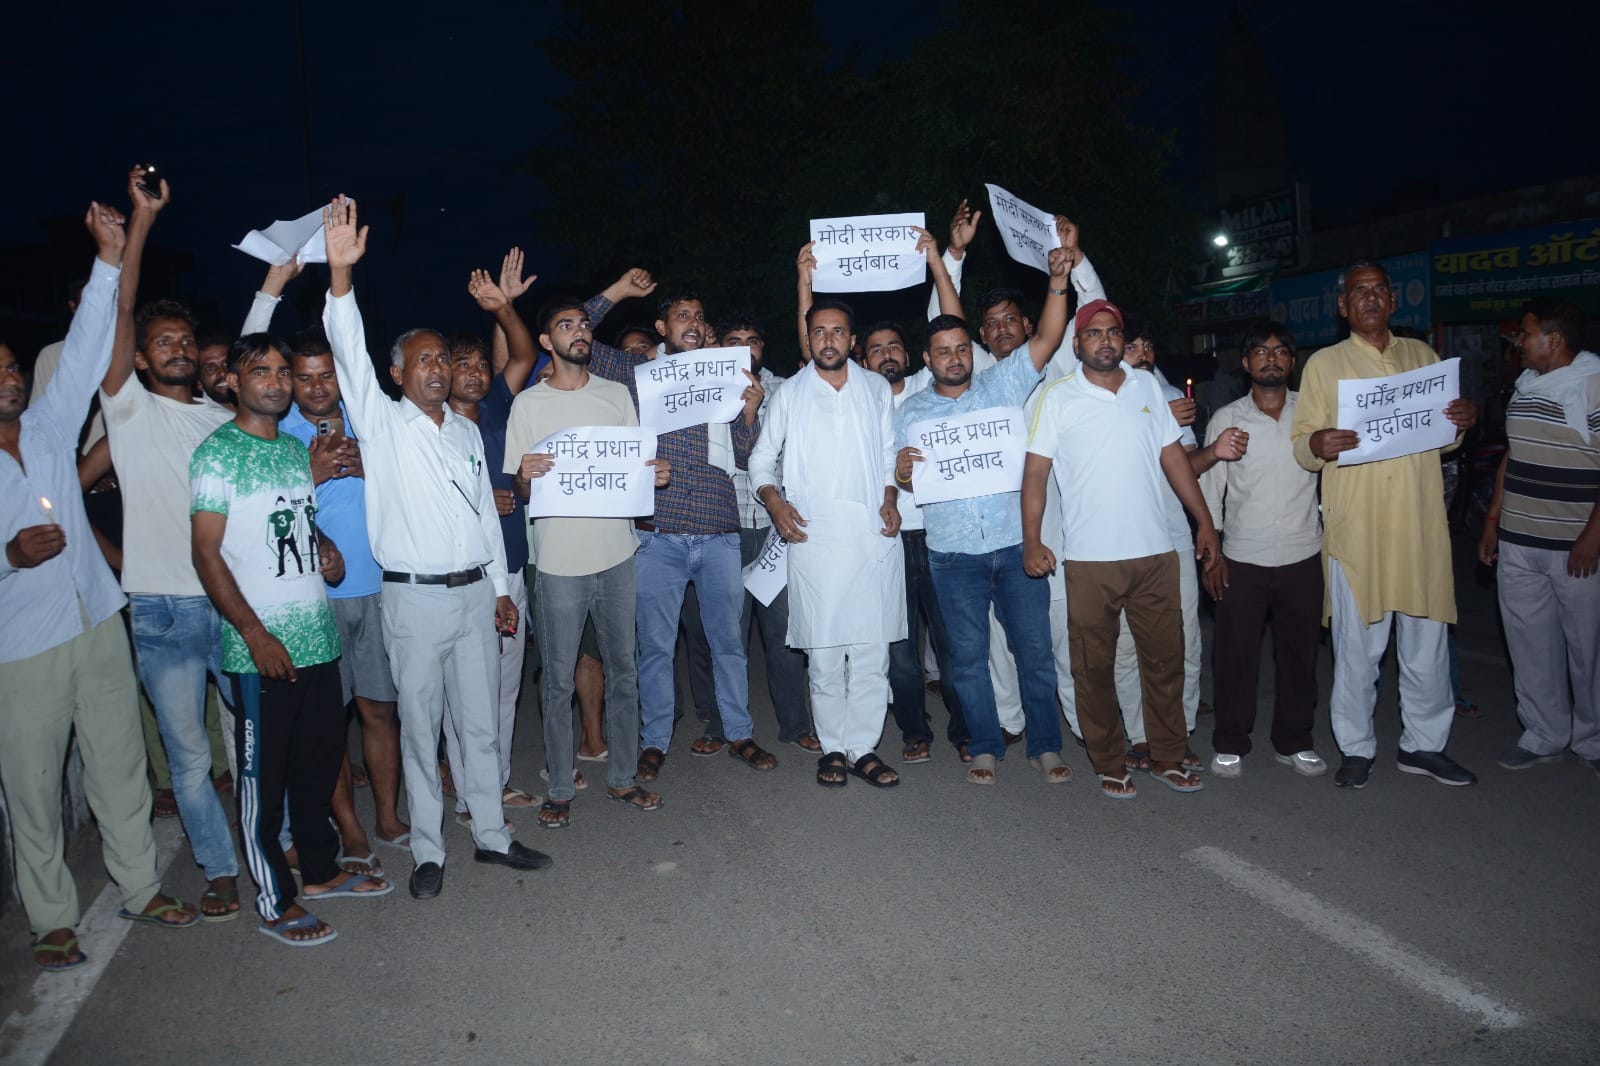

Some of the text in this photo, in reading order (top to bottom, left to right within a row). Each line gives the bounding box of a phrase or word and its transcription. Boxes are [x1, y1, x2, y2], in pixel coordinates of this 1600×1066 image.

[994, 192, 1019, 219] मोदी
[818, 223, 918, 245] मोदी सरकार
[837, 250, 900, 277] मुर्दाबाद
[1433, 246, 1520, 273] यादव
[650, 359, 737, 383] धर्मेंद्र प्रधान
[664, 385, 725, 413] मुर्दाबाद
[1356, 374, 1447, 410] धर्मेंद्र प्रधान
[920, 418, 1011, 449] धर्मेंद्र प्रधान
[1364, 408, 1434, 442] मुर्दाबाद
[546, 433, 642, 459] धर्मेंद्र प्रधान
[936, 449, 1004, 481] मुर्दाबाद
[557, 466, 629, 495] मुर्दाबाद
[277, 514, 288, 527] 3
[244, 719, 255, 770] adidas
